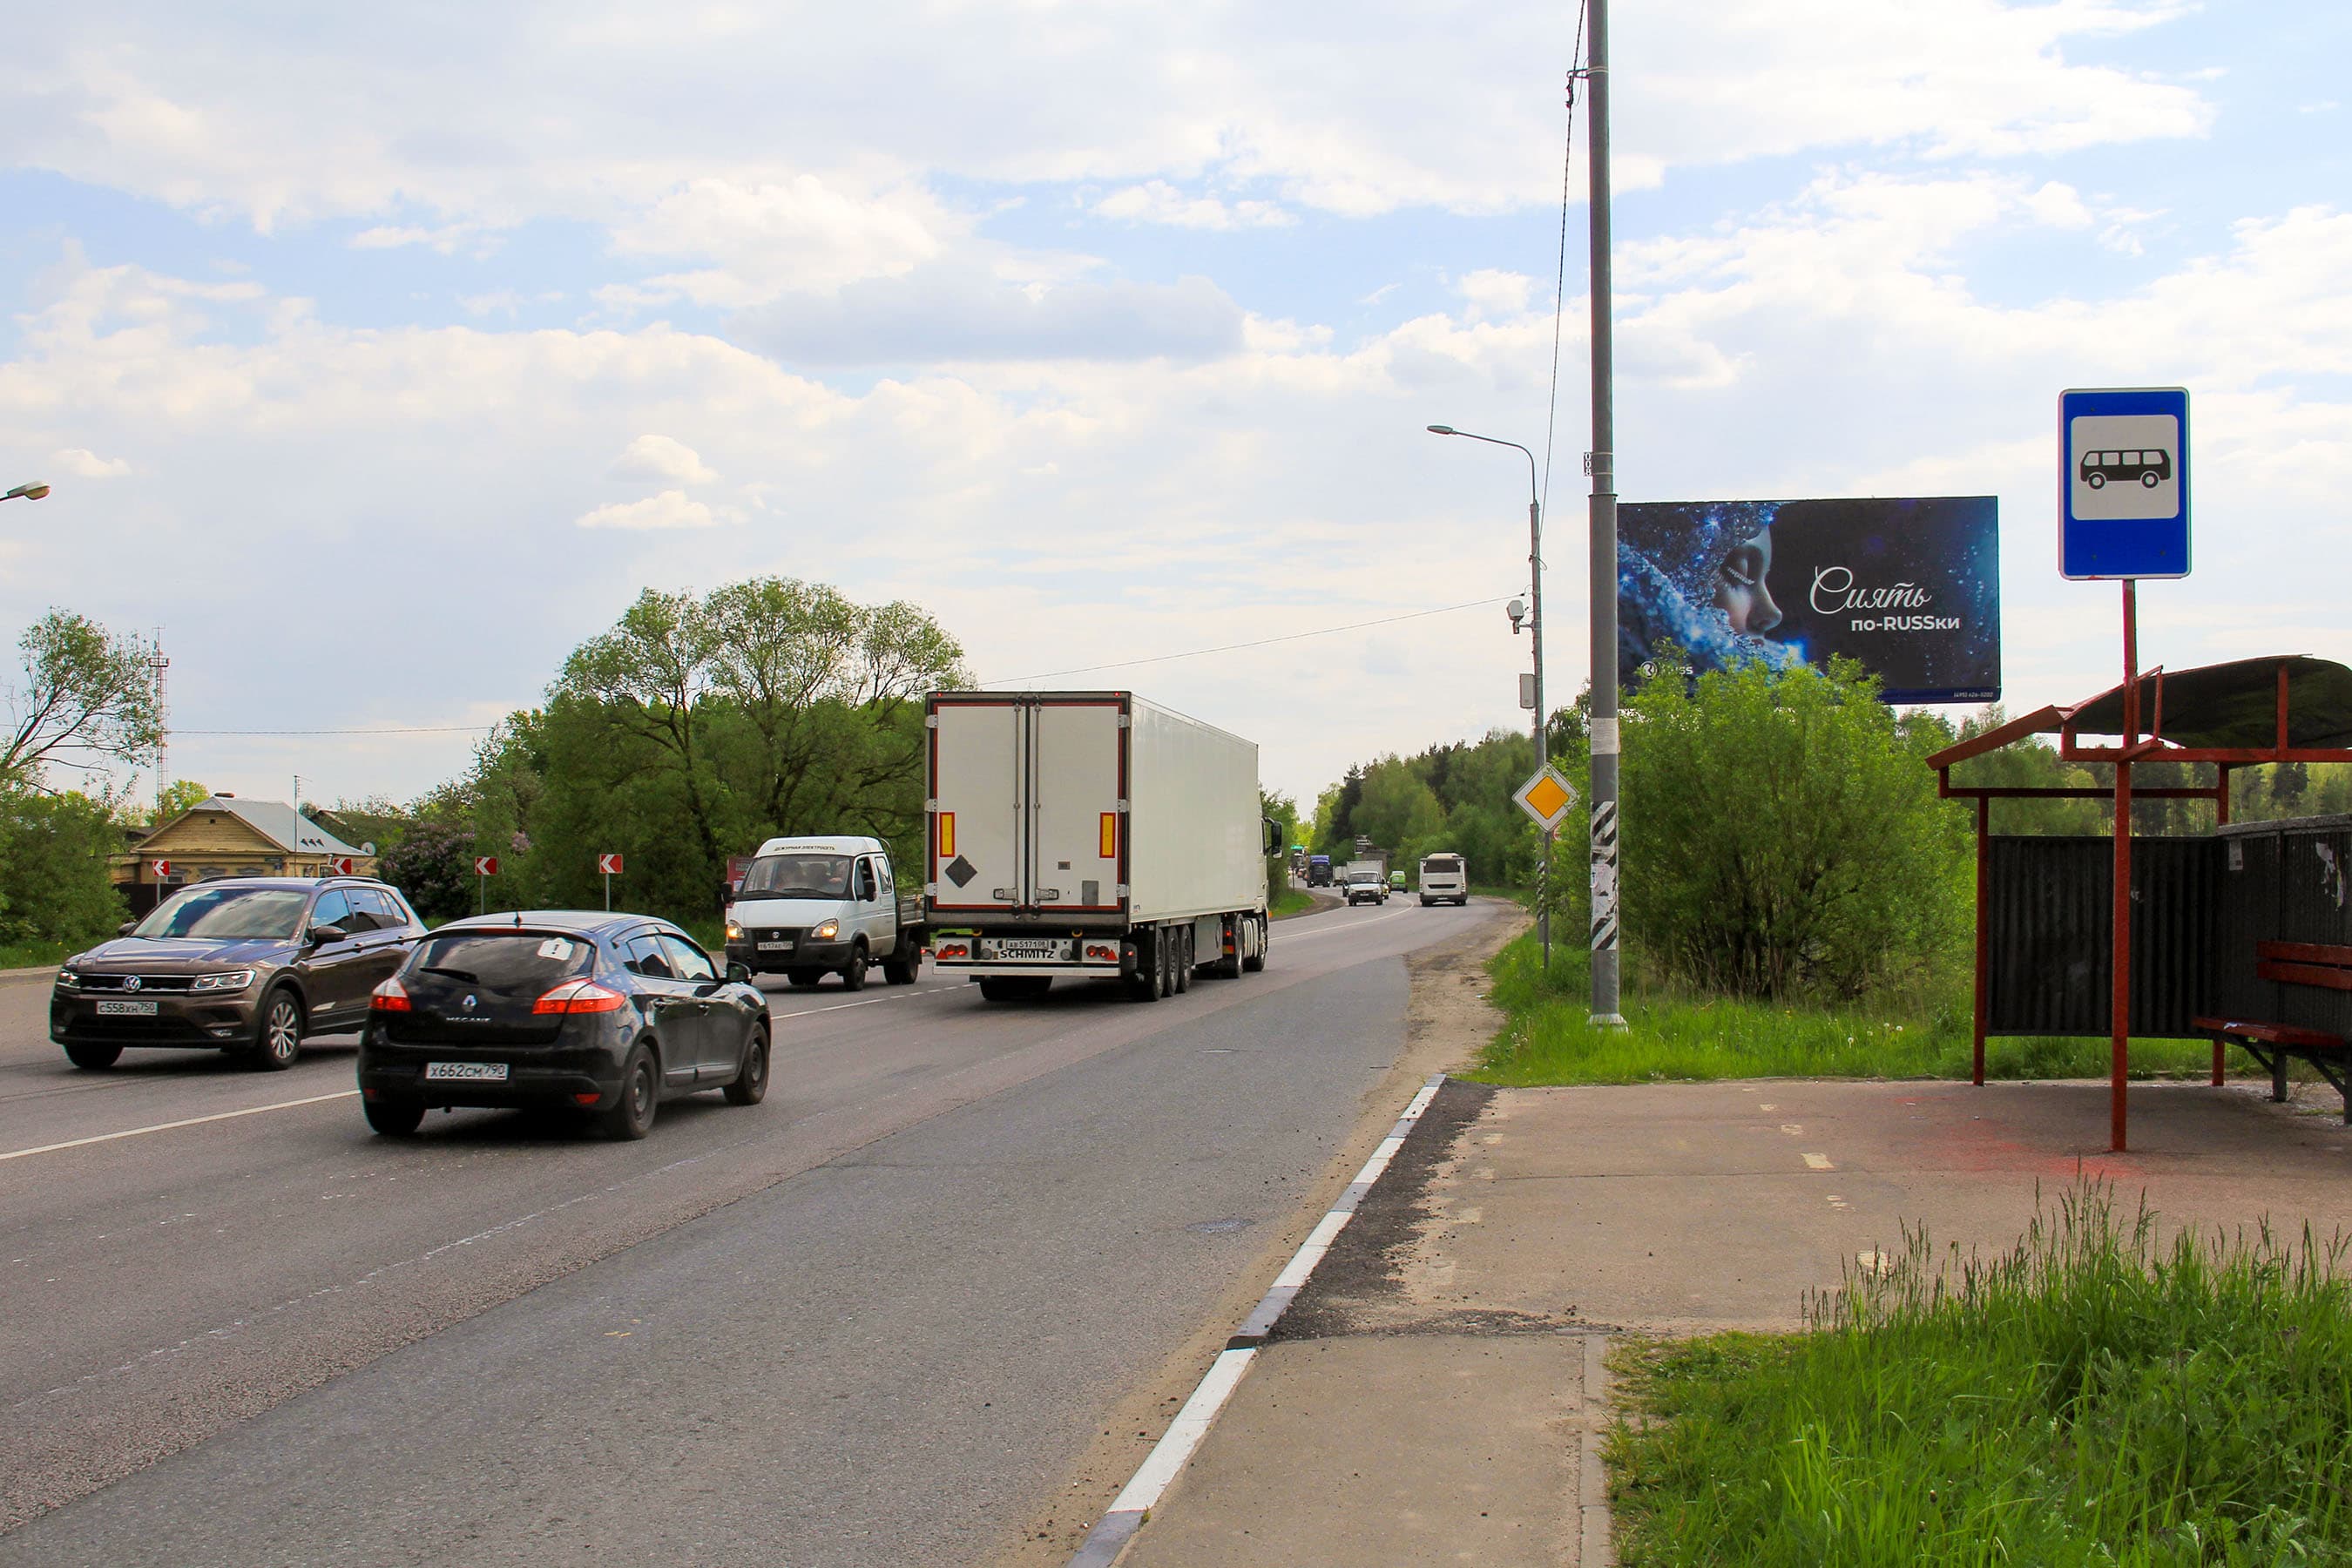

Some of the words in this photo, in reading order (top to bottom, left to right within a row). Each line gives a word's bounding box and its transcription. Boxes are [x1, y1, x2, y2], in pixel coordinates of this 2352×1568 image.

[1809, 565, 1932, 615] Сиять
[1851, 615, 1960, 632] по-RUSSки
[1000, 950, 1055, 959] SCHMITZ
